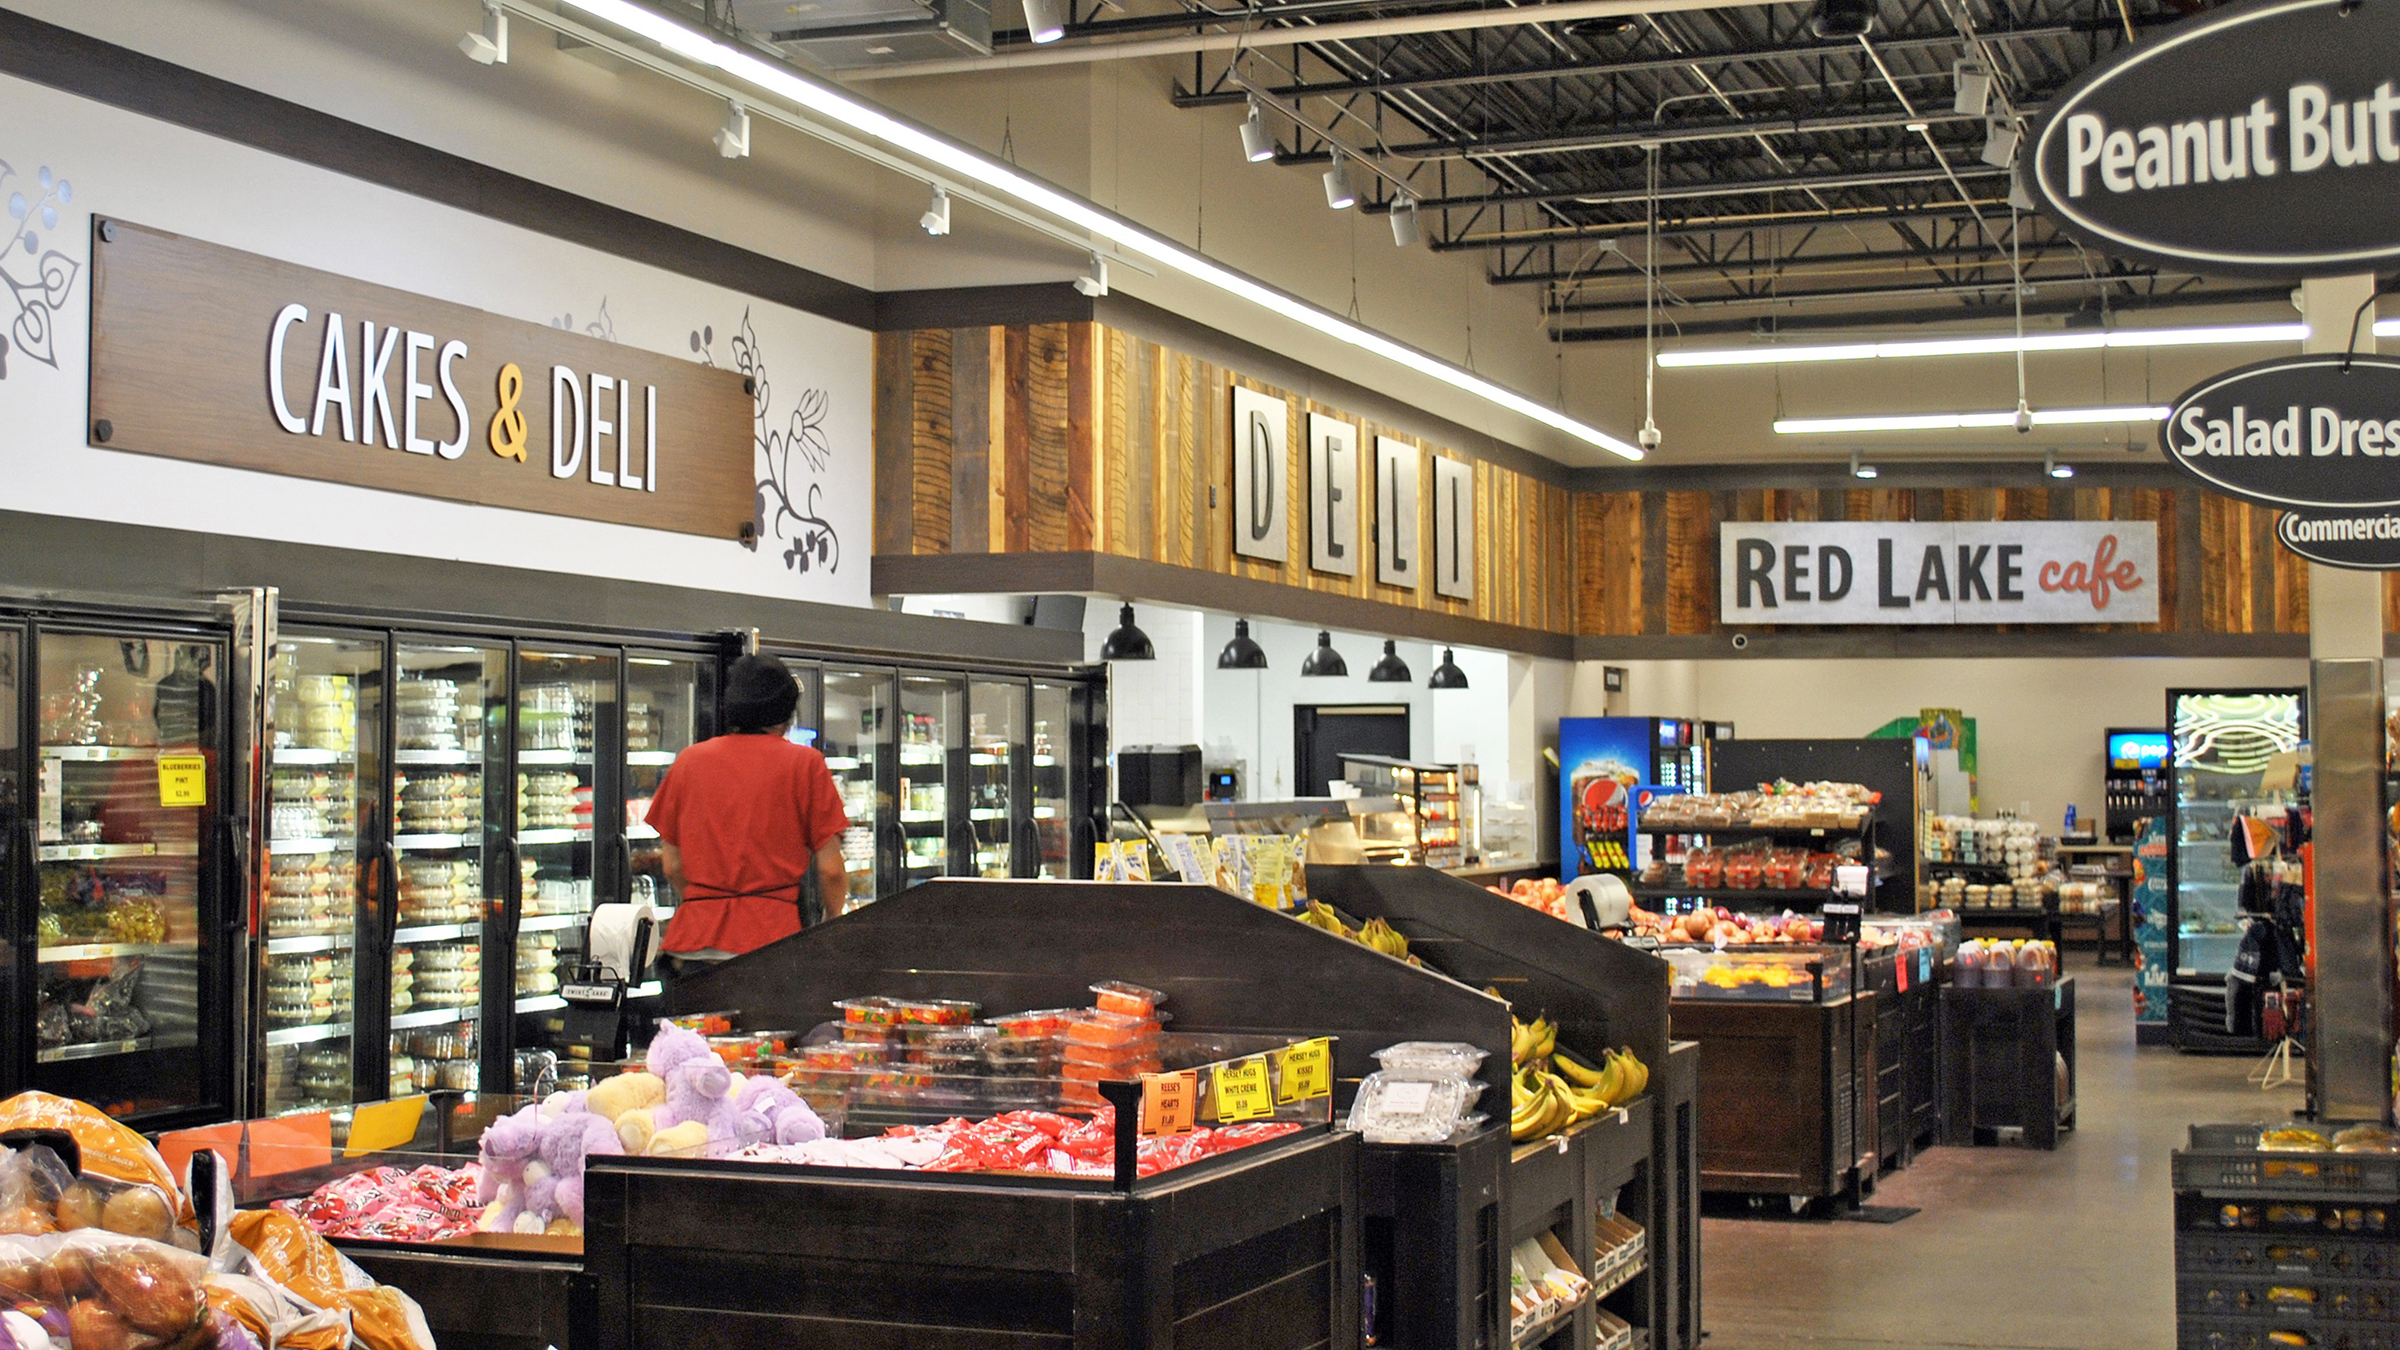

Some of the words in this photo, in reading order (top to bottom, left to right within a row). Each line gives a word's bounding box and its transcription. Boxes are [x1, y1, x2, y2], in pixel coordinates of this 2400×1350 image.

[2067, 98, 2276, 198] Peanut
[2288, 82, 2400, 173] But
[267, 303, 470, 461] CAKES
[490, 361, 529, 464] &
[552, 364, 657, 494] DELI
[2180, 405, 2300, 458] Salad
[2310, 405, 2400, 458] Dres
[1251, 410, 1458, 583] DELI
[2286, 513, 2400, 543] Commercia
[1736, 537, 1854, 609] RED
[1877, 537, 2025, 609] LAKE
[2038, 533, 2144, 611] cafe
[1289, 1051, 1308, 1062] HERSEY
[1309, 1049, 1321, 1058] HUGS
[1222, 1069, 1242, 1079] HERSEY
[1243, 1067, 1257, 1077] HUGS
[1297, 1065, 1314, 1075] KISSES
[1160, 1082, 1181, 1092] REESE'S
[1225, 1084, 1240, 1094] WHITE
[1160, 1098, 1180, 1109] HEARTS
